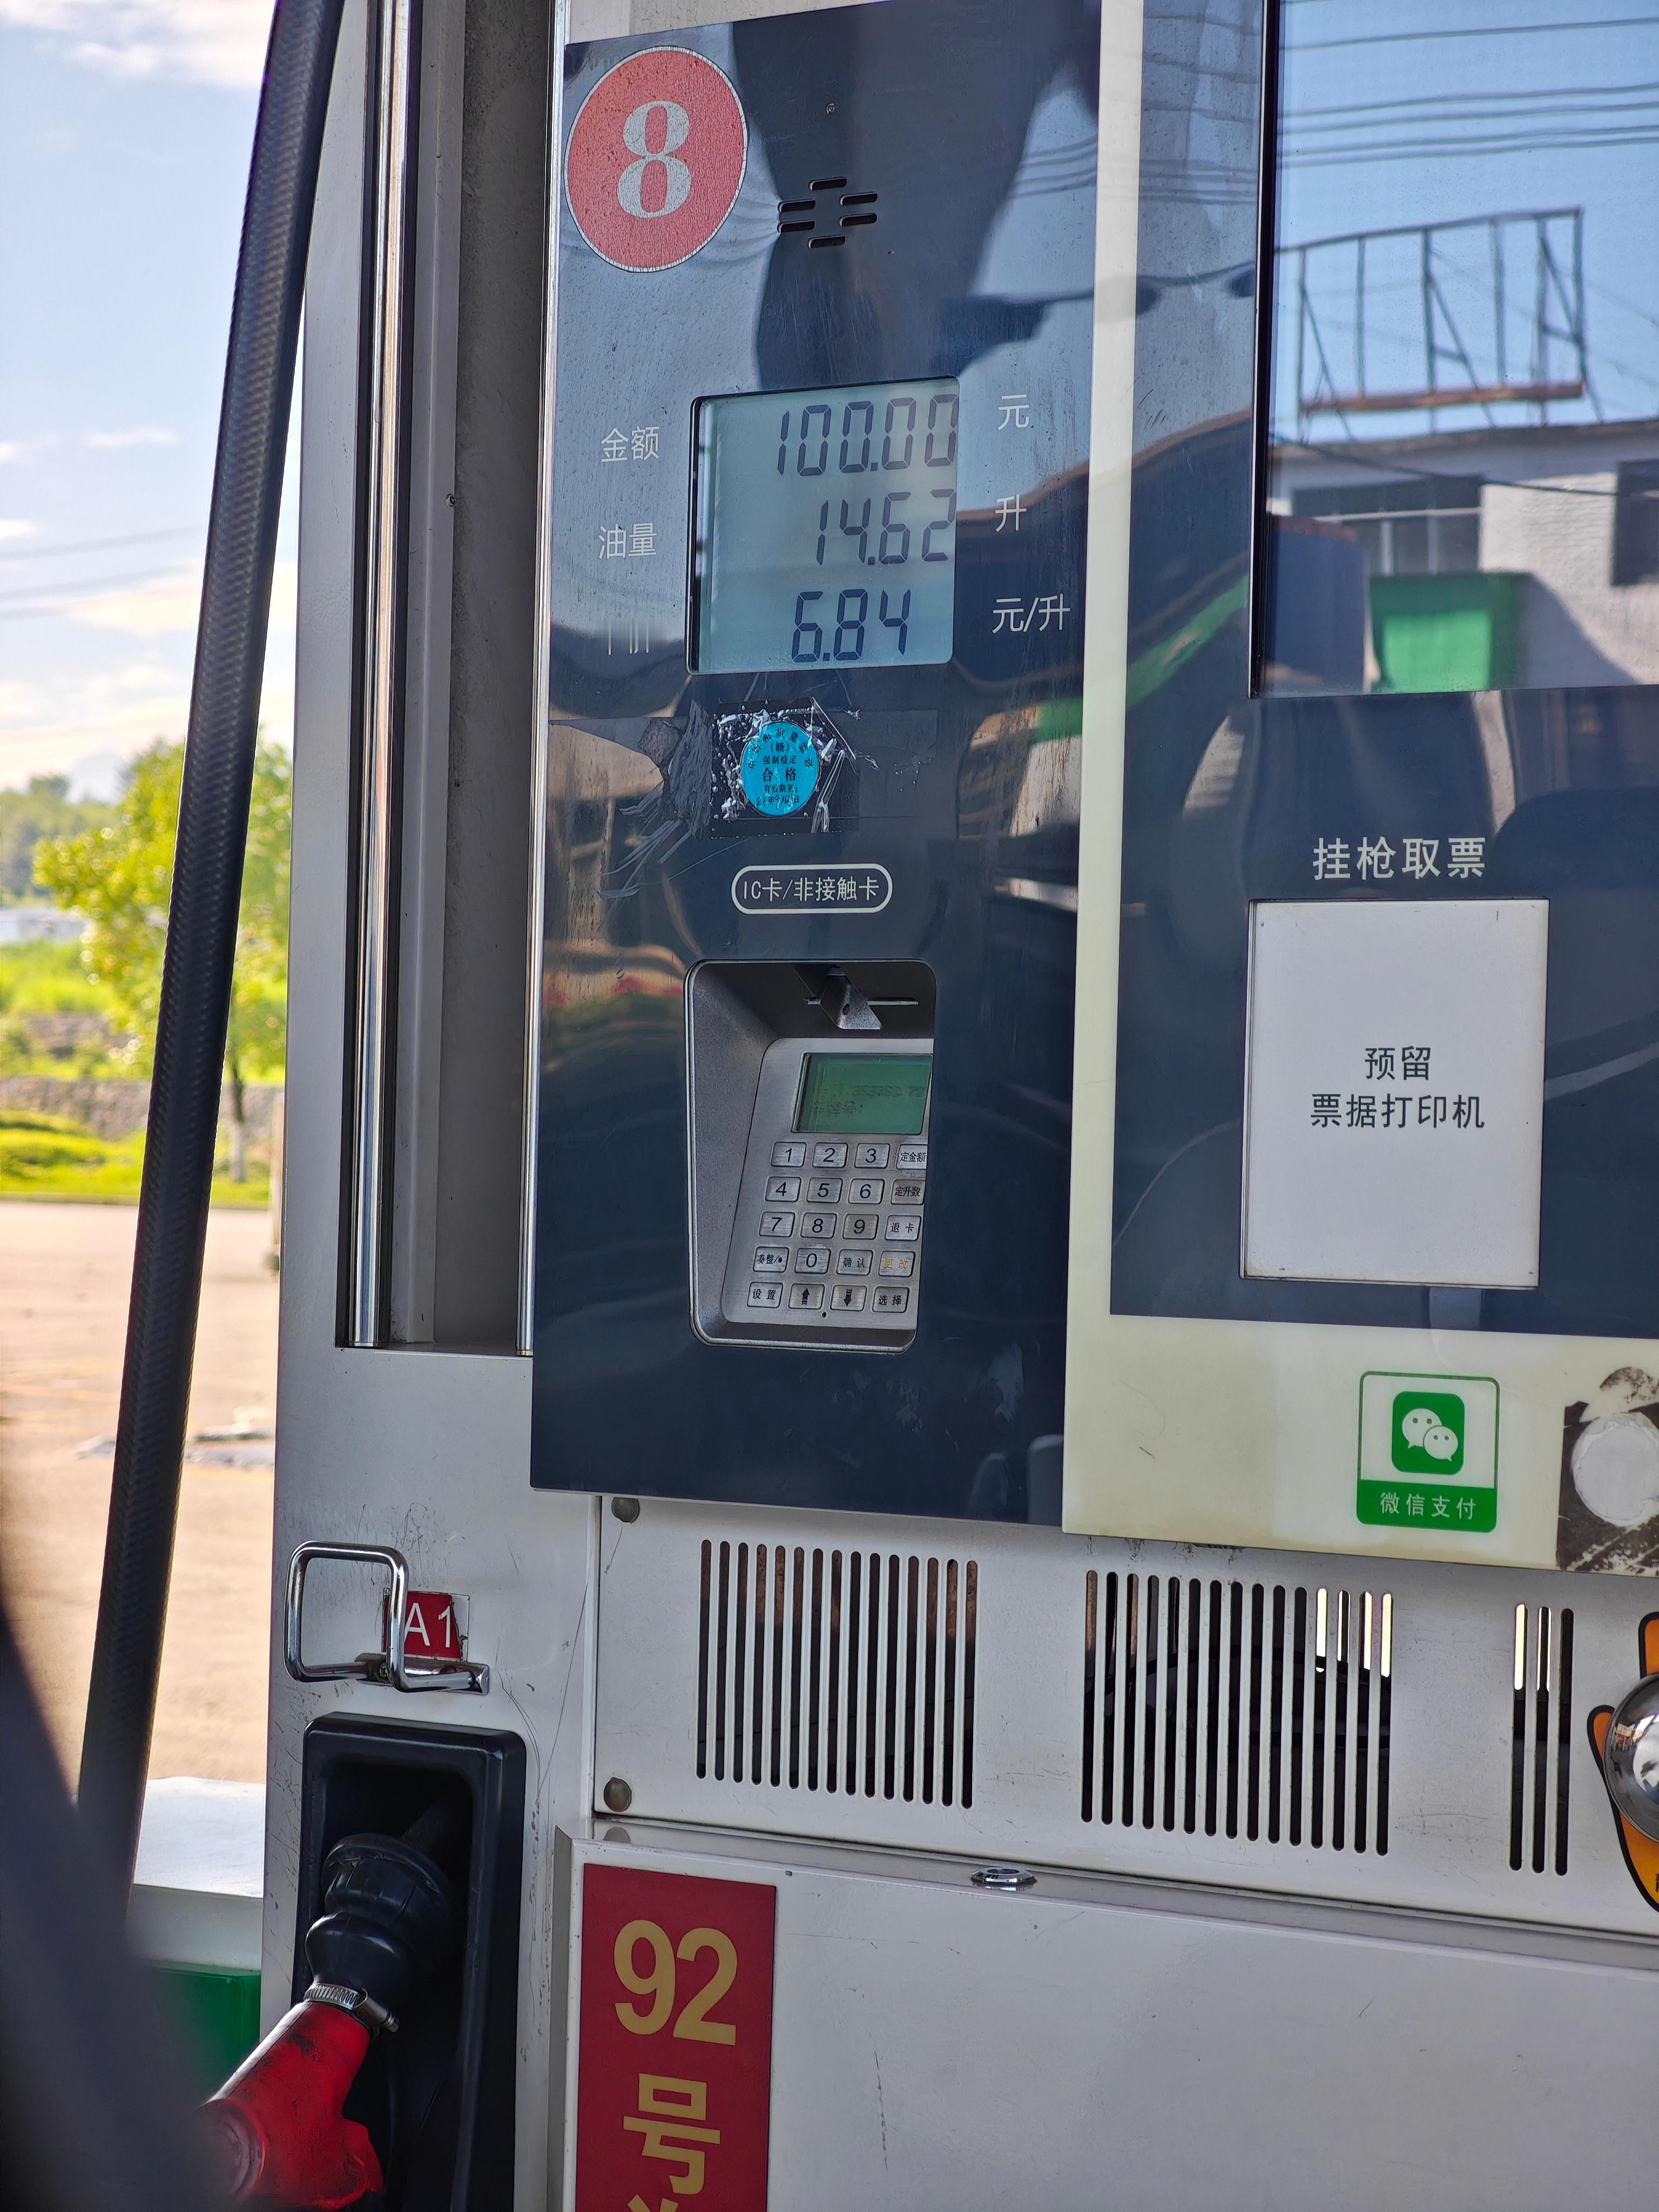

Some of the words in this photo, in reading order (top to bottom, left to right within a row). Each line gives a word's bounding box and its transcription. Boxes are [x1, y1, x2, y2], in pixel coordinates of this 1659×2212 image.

[617, 100, 691, 219] 8
[997, 393, 1030, 431] 元
[600, 425, 660, 463] 金额
[777, 393, 959, 476] 100.00
[814, 488, 957, 566] 14.62
[995, 495, 1027, 533] 升
[598, 523, 658, 560] 油量
[791, 588, 911, 663] 6.84
[991, 593, 1071, 633] 元/升
[763, 755, 797, 765] 强制检定
[762, 766, 797, 782] 合格
[1312, 835, 1487, 882] 挂枪取票
[743, 876, 880, 902] IC卡/非接触卡
[1364, 1045, 1433, 1082] 预留
[1310, 1092, 1486, 1130] 票据打印机
[784, 1147, 793, 1163] 1
[822, 1147, 836, 1163] 2
[865, 1148, 877, 1164] 3
[899, 1151, 926, 1163] 定金额
[775, 1182, 787, 1197] 4
[817, 1183, 831, 1198] 5
[859, 1184, 872, 1199] 6
[894, 1185, 921, 1198] 定升数
[771, 1217, 783, 1232] 7
[811, 1218, 824, 1233] 8
[853, 1219, 866, 1234] 9
[805, 1252, 818, 1268] 0
[1380, 1491, 1476, 1521] 微信支付
[403, 1602, 451, 1649] A1
